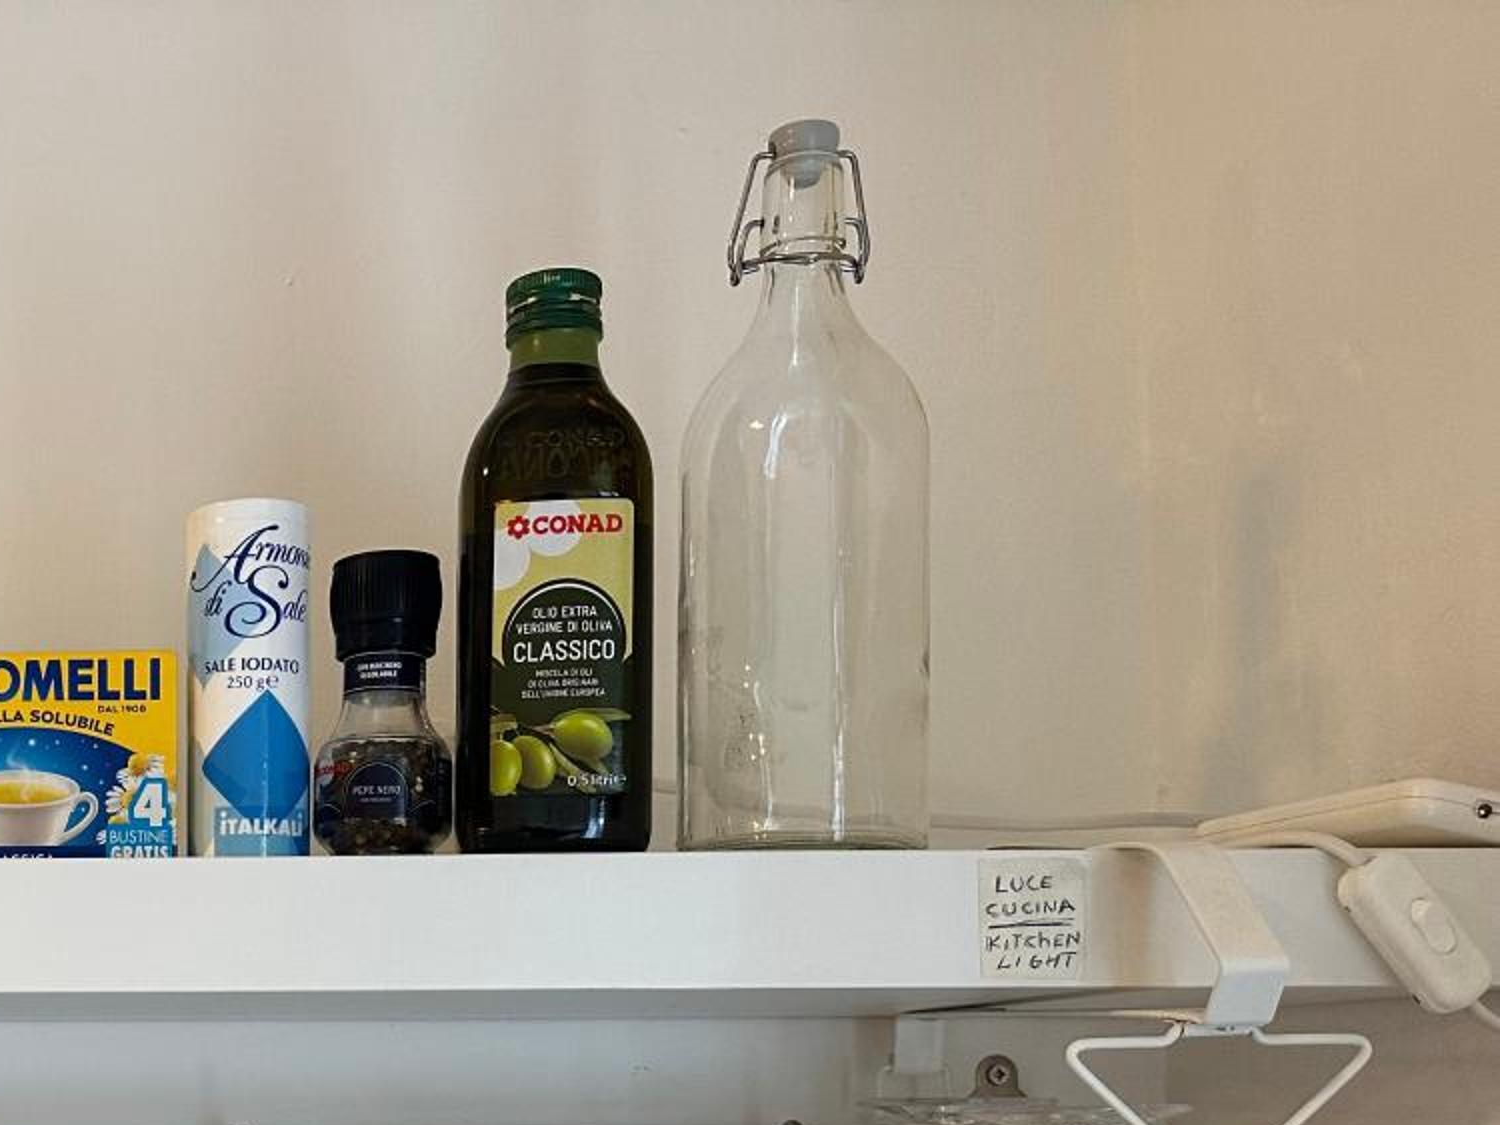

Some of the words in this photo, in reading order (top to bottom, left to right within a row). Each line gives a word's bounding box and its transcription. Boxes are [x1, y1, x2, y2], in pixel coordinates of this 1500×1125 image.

[532, 513, 624, 535] CONAD
[204, 580, 232, 618] di
[225, 565, 308, 639] Sale
[532, 606, 558, 619] OLIO
[561, 605, 598, 619] EXTRA
[516, 621, 563, 635] VERGINE
[567, 621, 579, 633] DI
[581, 619, 613, 633] OLIVA
[513, 639, 616, 663] CLASSICO
[204, 658, 237, 676] SALE
[241, 657, 301, 676] IODATO
[227, 675, 253, 690] 250
[98, 705, 120, 714] DAL
[29, 709, 115, 737] SOLUBILE
[133, 783, 167, 828] 4
[109, 829, 168, 845] BUSTINE
[111, 845, 169, 858] GRATIS
[995, 874, 1054, 894] LUCE
[985, 898, 1077, 918] CUCINA
[997, 951, 1077, 970] LIGHT
